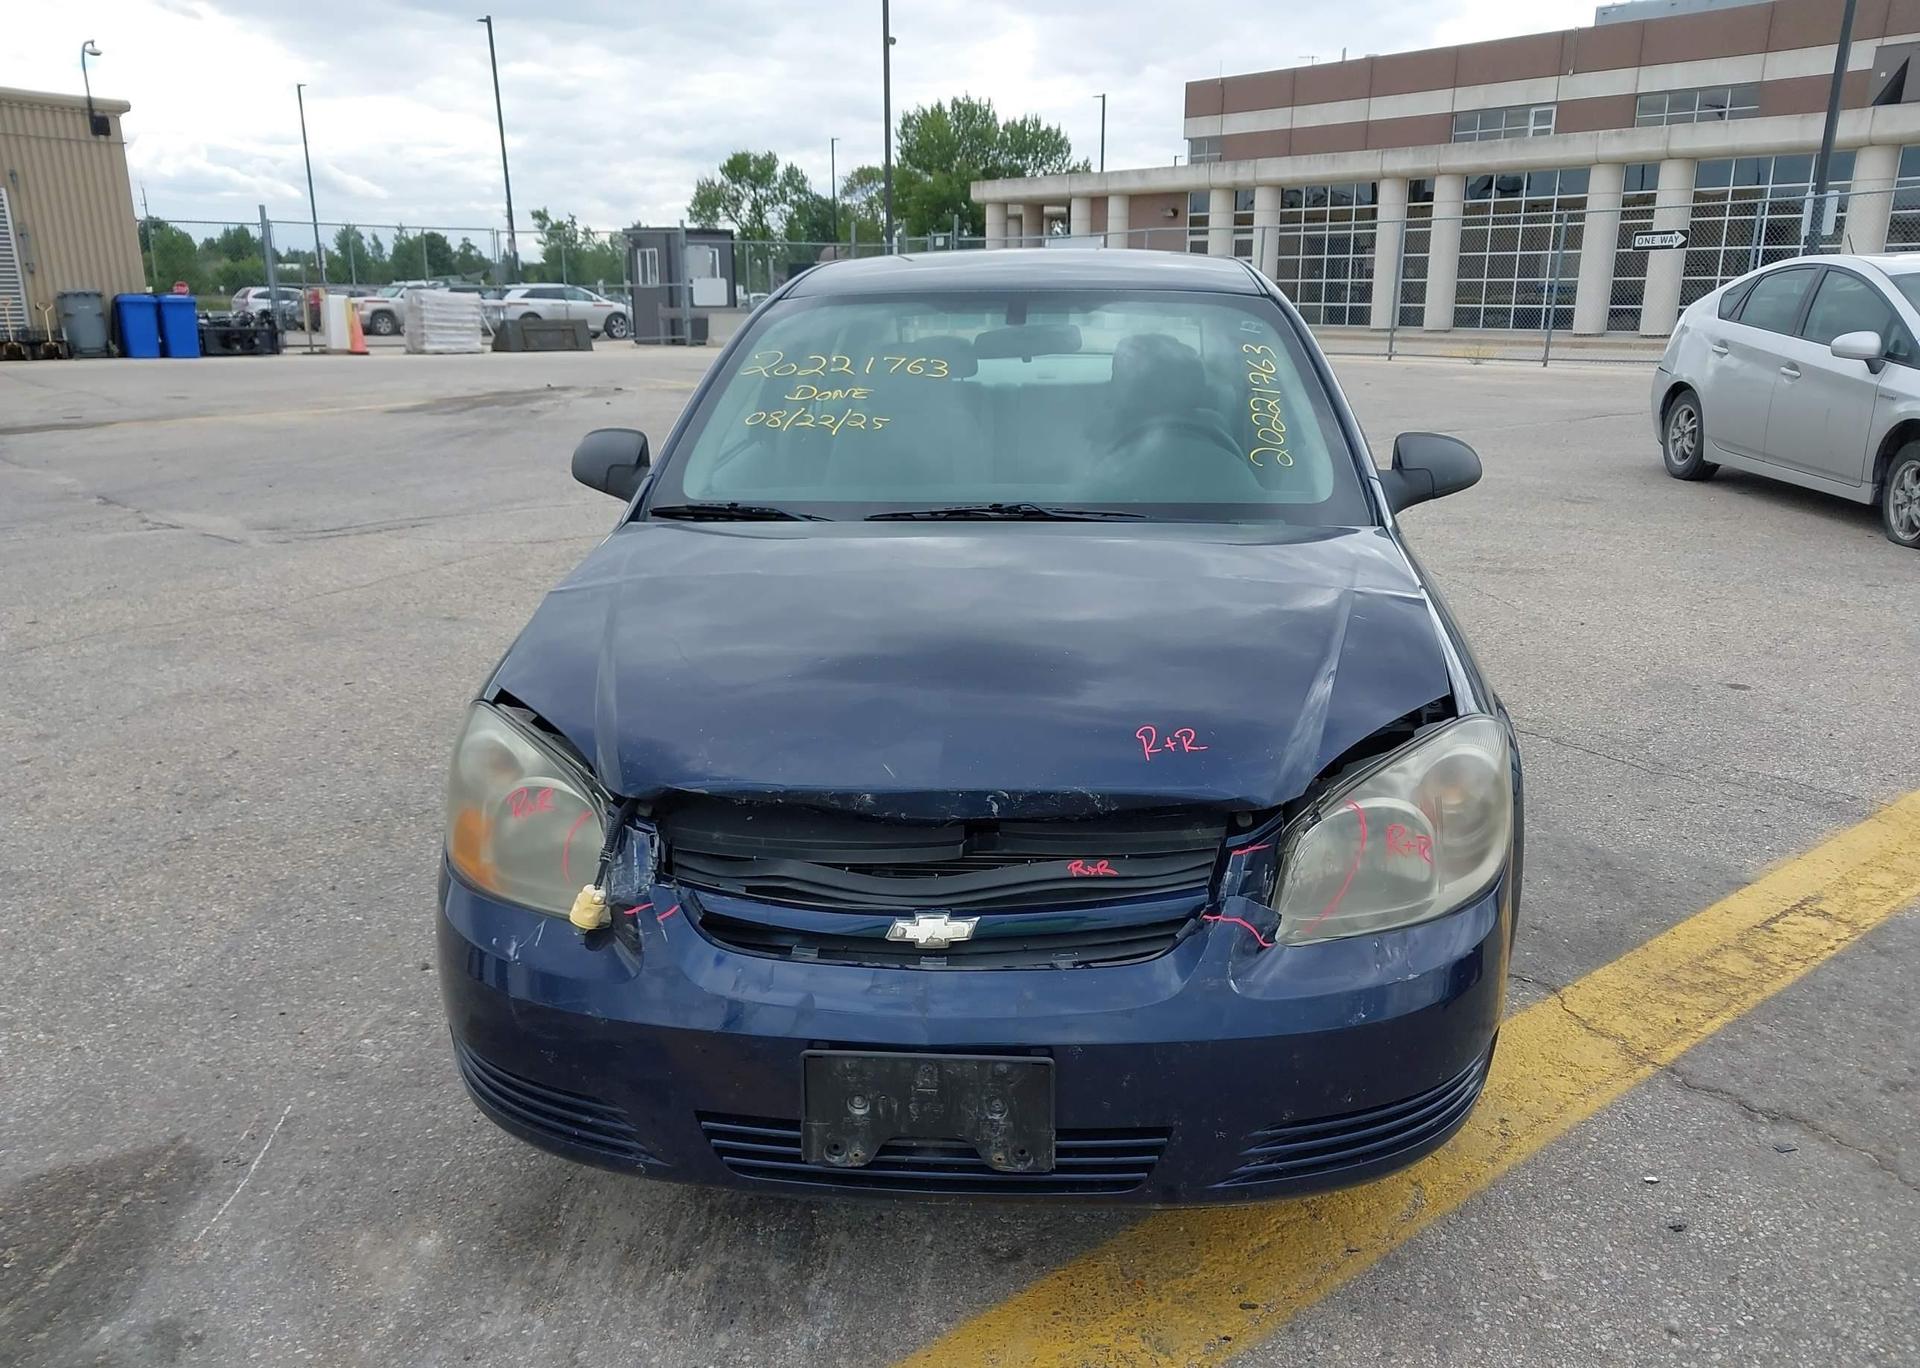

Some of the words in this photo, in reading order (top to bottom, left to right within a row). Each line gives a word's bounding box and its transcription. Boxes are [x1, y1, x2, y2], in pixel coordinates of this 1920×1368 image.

[1637, 236, 1656, 245] ONE
[1660, 235, 1680, 244] WAY
[741, 350, 949, 377] 20221763
[784, 385, 874, 400] DONE
[1242, 343, 1293, 467] 20221763
[744, 407, 890, 436] 08/22/25
[1135, 725, 1209, 761] R+R
